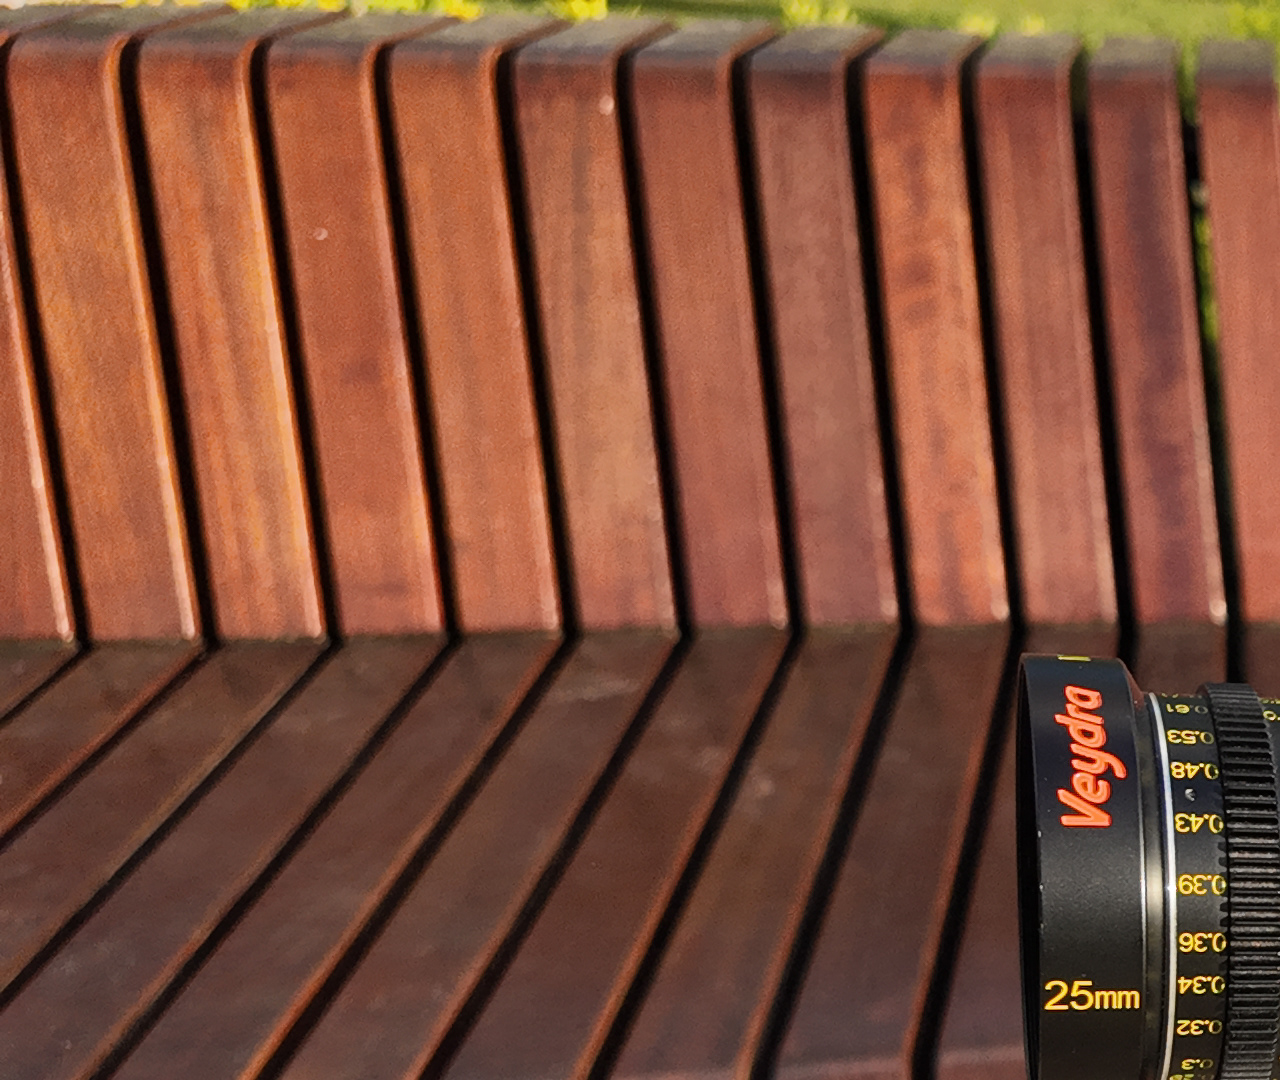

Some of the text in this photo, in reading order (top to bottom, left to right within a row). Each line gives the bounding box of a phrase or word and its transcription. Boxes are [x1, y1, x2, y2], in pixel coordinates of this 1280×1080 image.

[1167, 729, 1215, 745] 0.53
[1054, 684, 1127, 828] Veydra
[1170, 761, 1219, 780] 0.48
[1175, 813, 1224, 834] 0.43
[1178, 874, 1227, 896] 0.39
[1178, 932, 1227, 952] 0.36
[1178, 976, 1226, 994] 0.34
[1044, 979, 1141, 1012] 25mm
[1176, 1019, 1223, 1036] 0.32
[1181, 1058, 1214, 1070] 0.3
